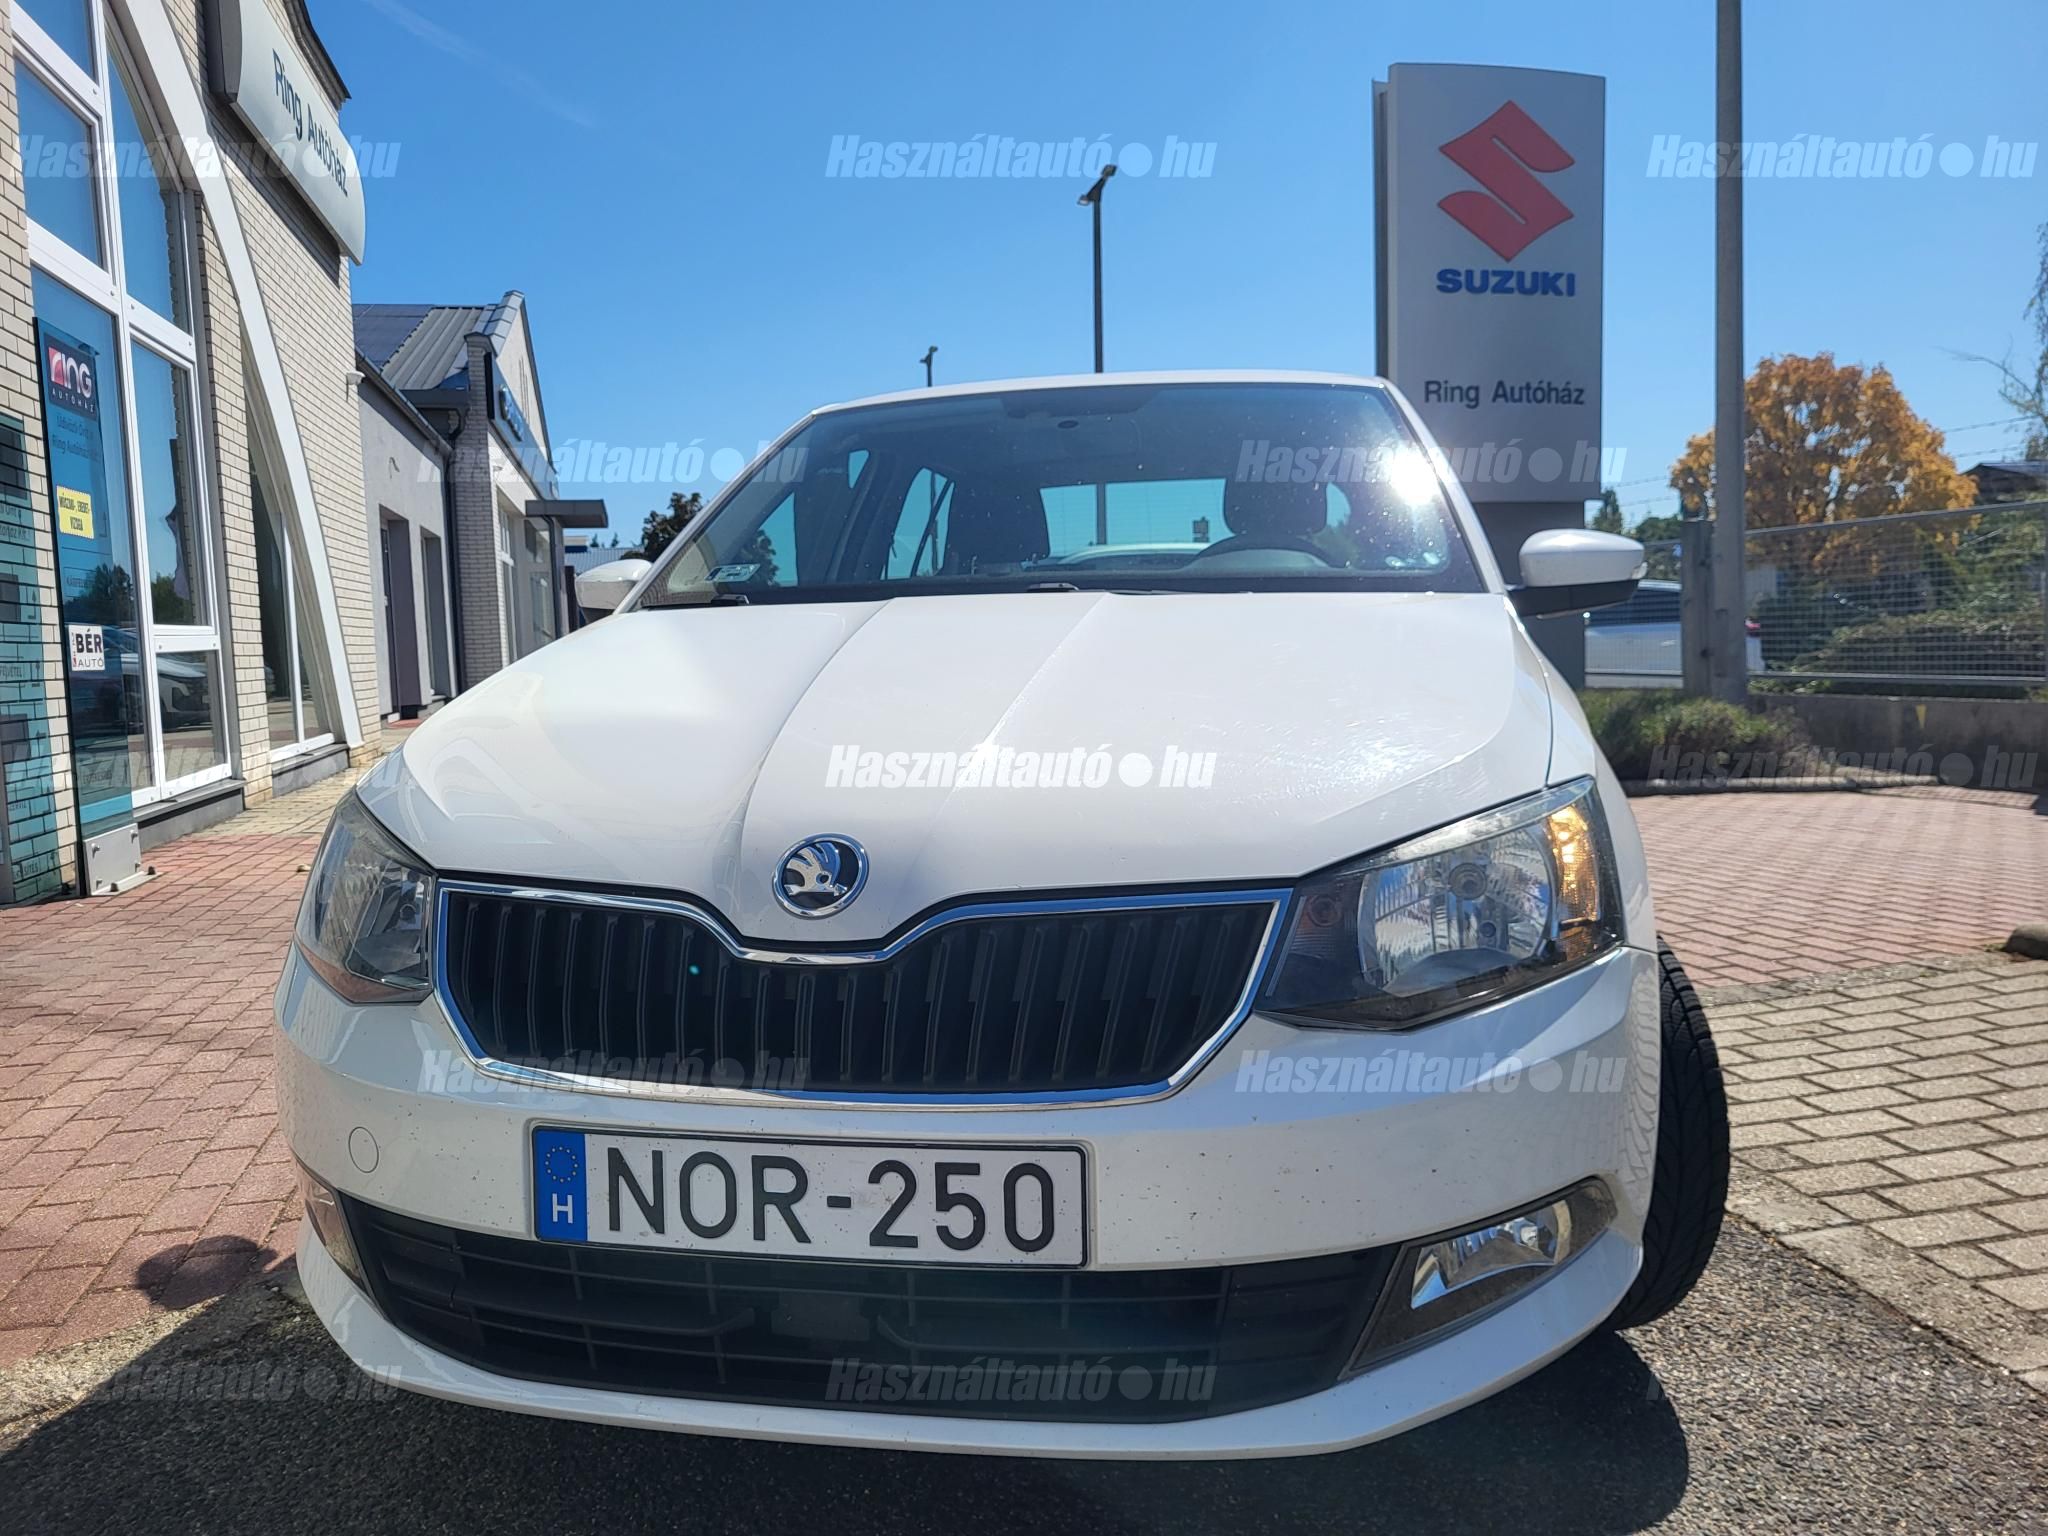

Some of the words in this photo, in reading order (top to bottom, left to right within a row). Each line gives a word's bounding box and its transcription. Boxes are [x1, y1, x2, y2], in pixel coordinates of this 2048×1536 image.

[272, 48, 303, 141] Ring
[1436, 268, 1576, 297] SUZUKI
[1424, 380, 1480, 409] Ring
[1492, 379, 1585, 405] Autóház
[75, 628, 103, 653] BÉR
[79, 657, 104, 667] AUTÓ
[551, 1193, 574, 1224] H
[607, 1147, 1055, 1253] NOR-250
